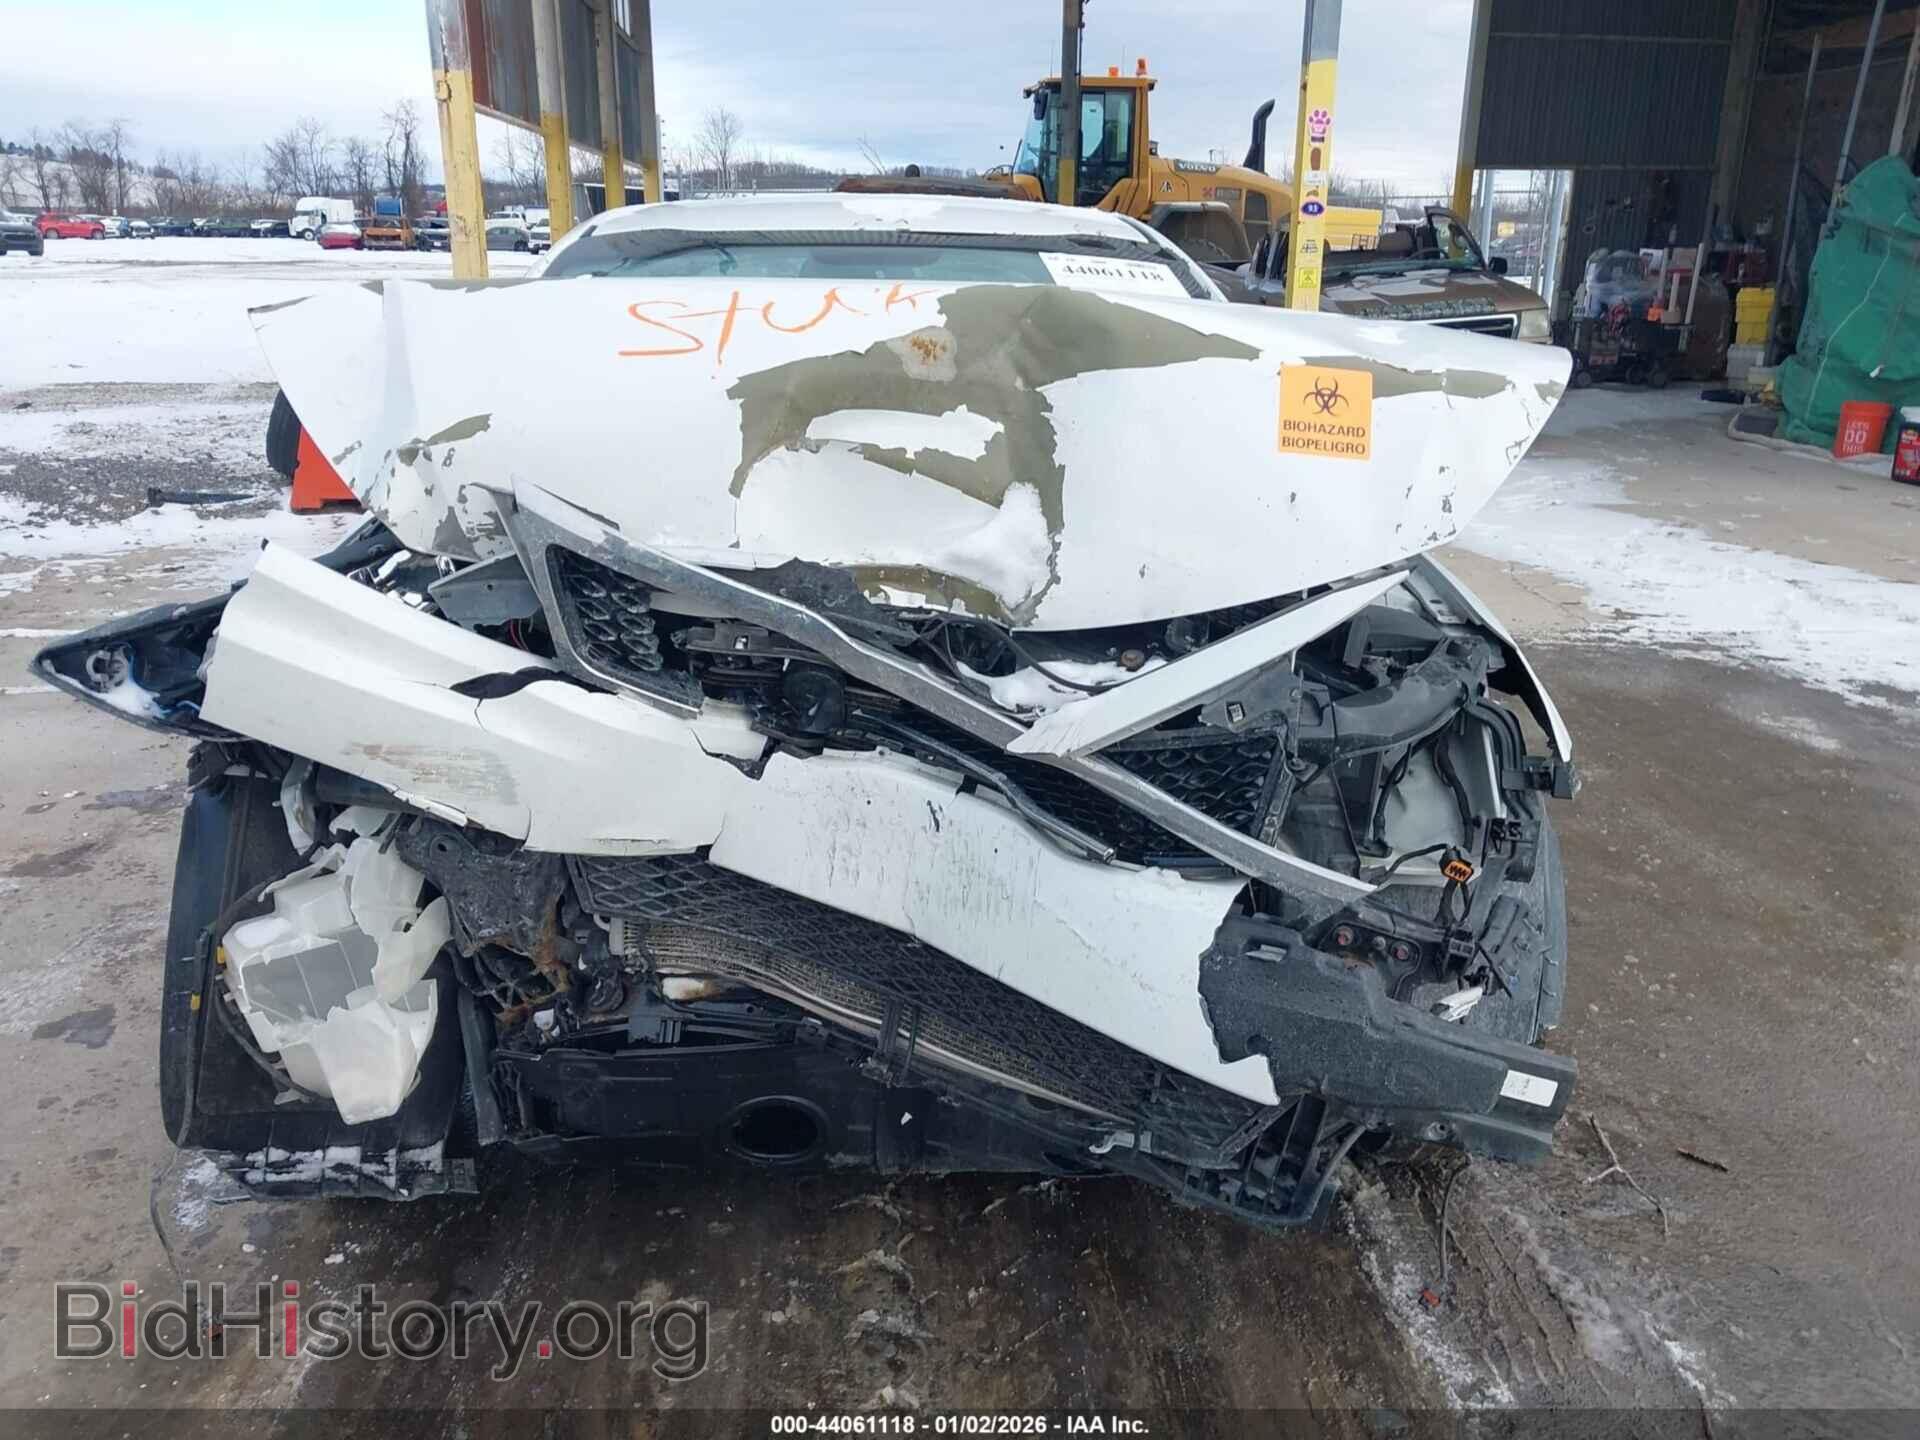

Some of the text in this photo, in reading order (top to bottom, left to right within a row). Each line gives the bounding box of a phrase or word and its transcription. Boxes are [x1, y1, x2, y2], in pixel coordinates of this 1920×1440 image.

[1178, 160, 1216, 173] VOLVO
[1283, 419, 1366, 438] BIOHAZARD
[1282, 435, 1366, 455] BIOPELIGRO
